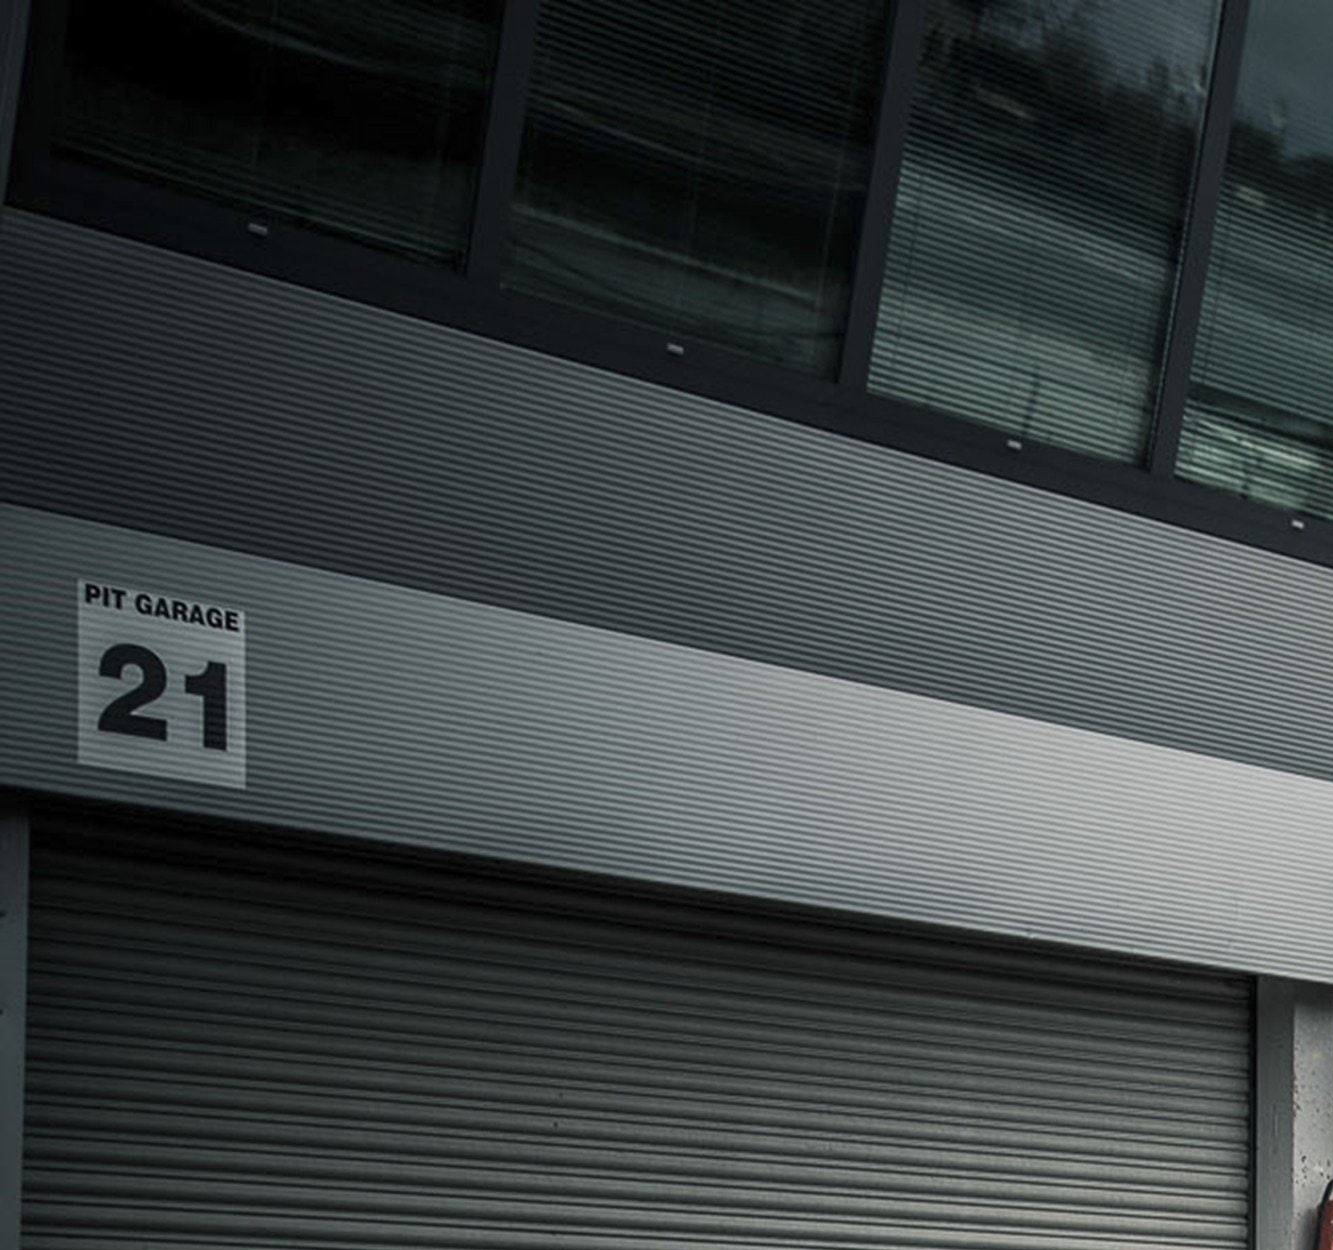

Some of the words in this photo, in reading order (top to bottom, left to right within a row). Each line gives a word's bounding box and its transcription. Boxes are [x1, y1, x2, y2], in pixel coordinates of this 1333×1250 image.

[85, 583, 126, 610] PIT
[135, 594, 240, 632] GARAGE
[98, 643, 228, 751] 21
